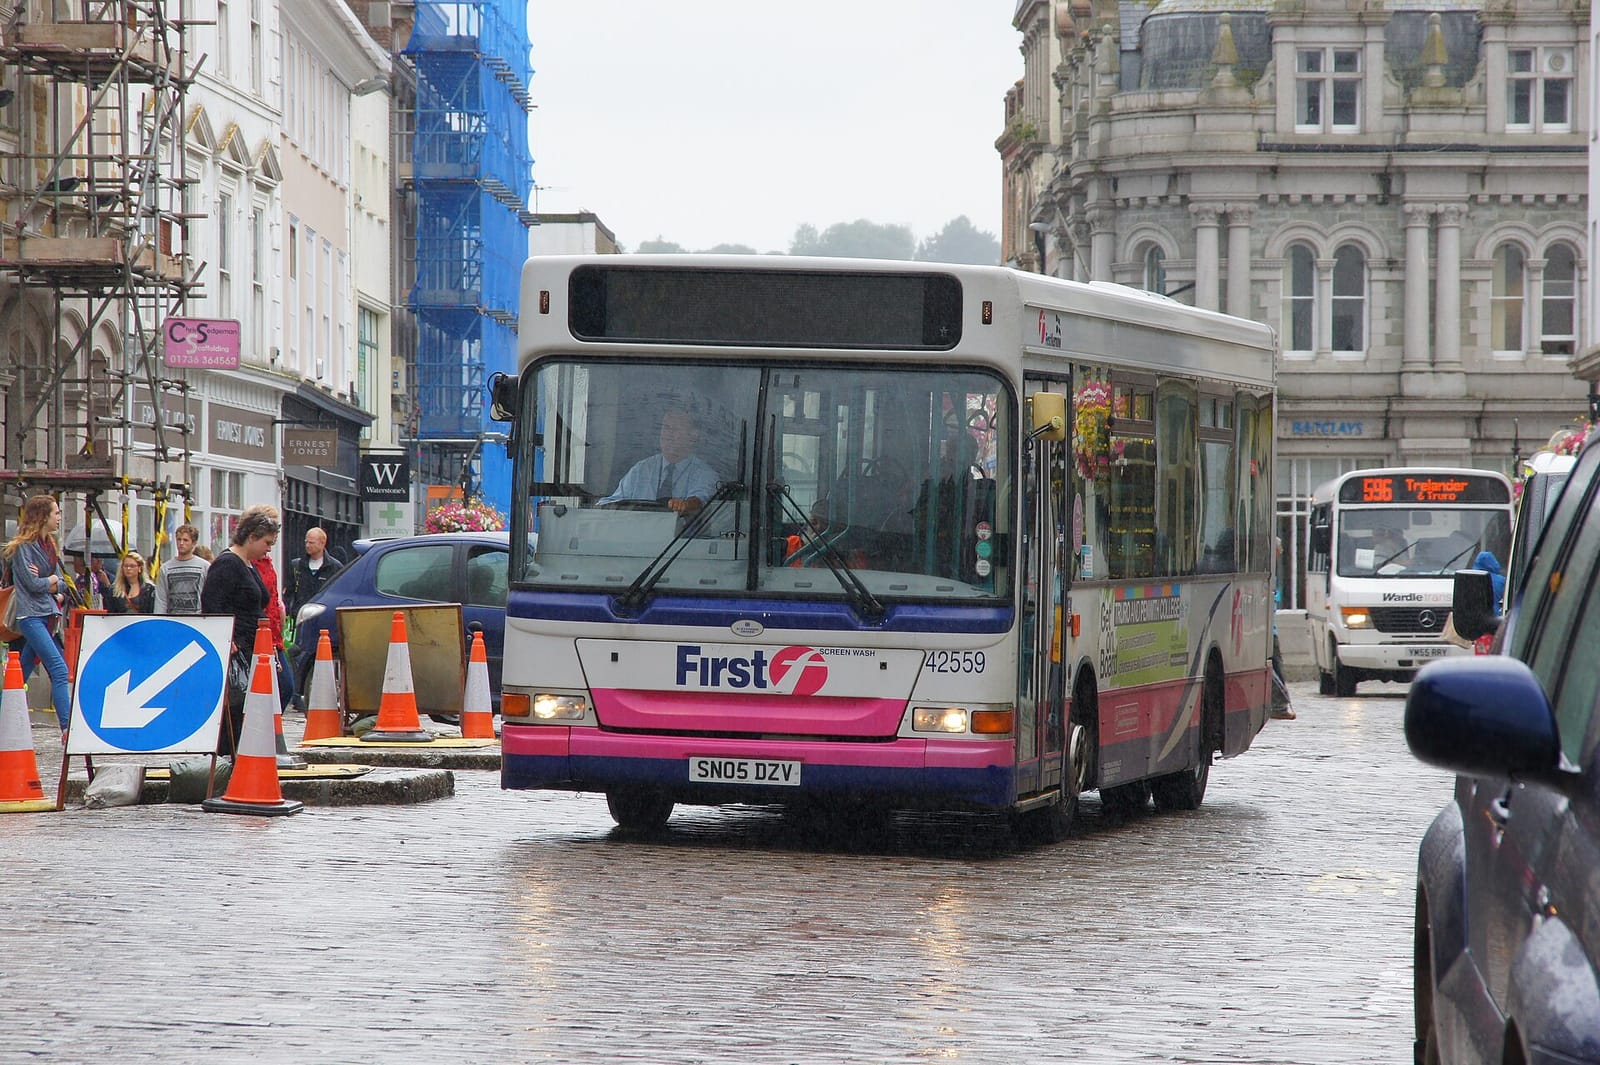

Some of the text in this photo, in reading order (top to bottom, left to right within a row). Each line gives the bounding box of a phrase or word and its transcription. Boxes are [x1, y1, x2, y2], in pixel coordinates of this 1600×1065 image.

[217, 420, 265, 448] ERNEST JONES
[1292, 420, 1363, 435] BARCLAYS
[289, 439, 332, 448] ERNEST
[292, 448, 328, 456] JONES
[370, 462, 402, 486] W
[366, 486, 406, 494] Waterstone's
[373, 528, 409, 537] pharmacy
[1100, 602, 1112, 632] Get
[819, 648, 875, 657] SCREEN WASH
[926, 651, 986, 673] 42559
[676, 645, 768, 689] First
[1100, 648, 1117, 679] Board
[697, 760, 793, 781] SN05 DZV
